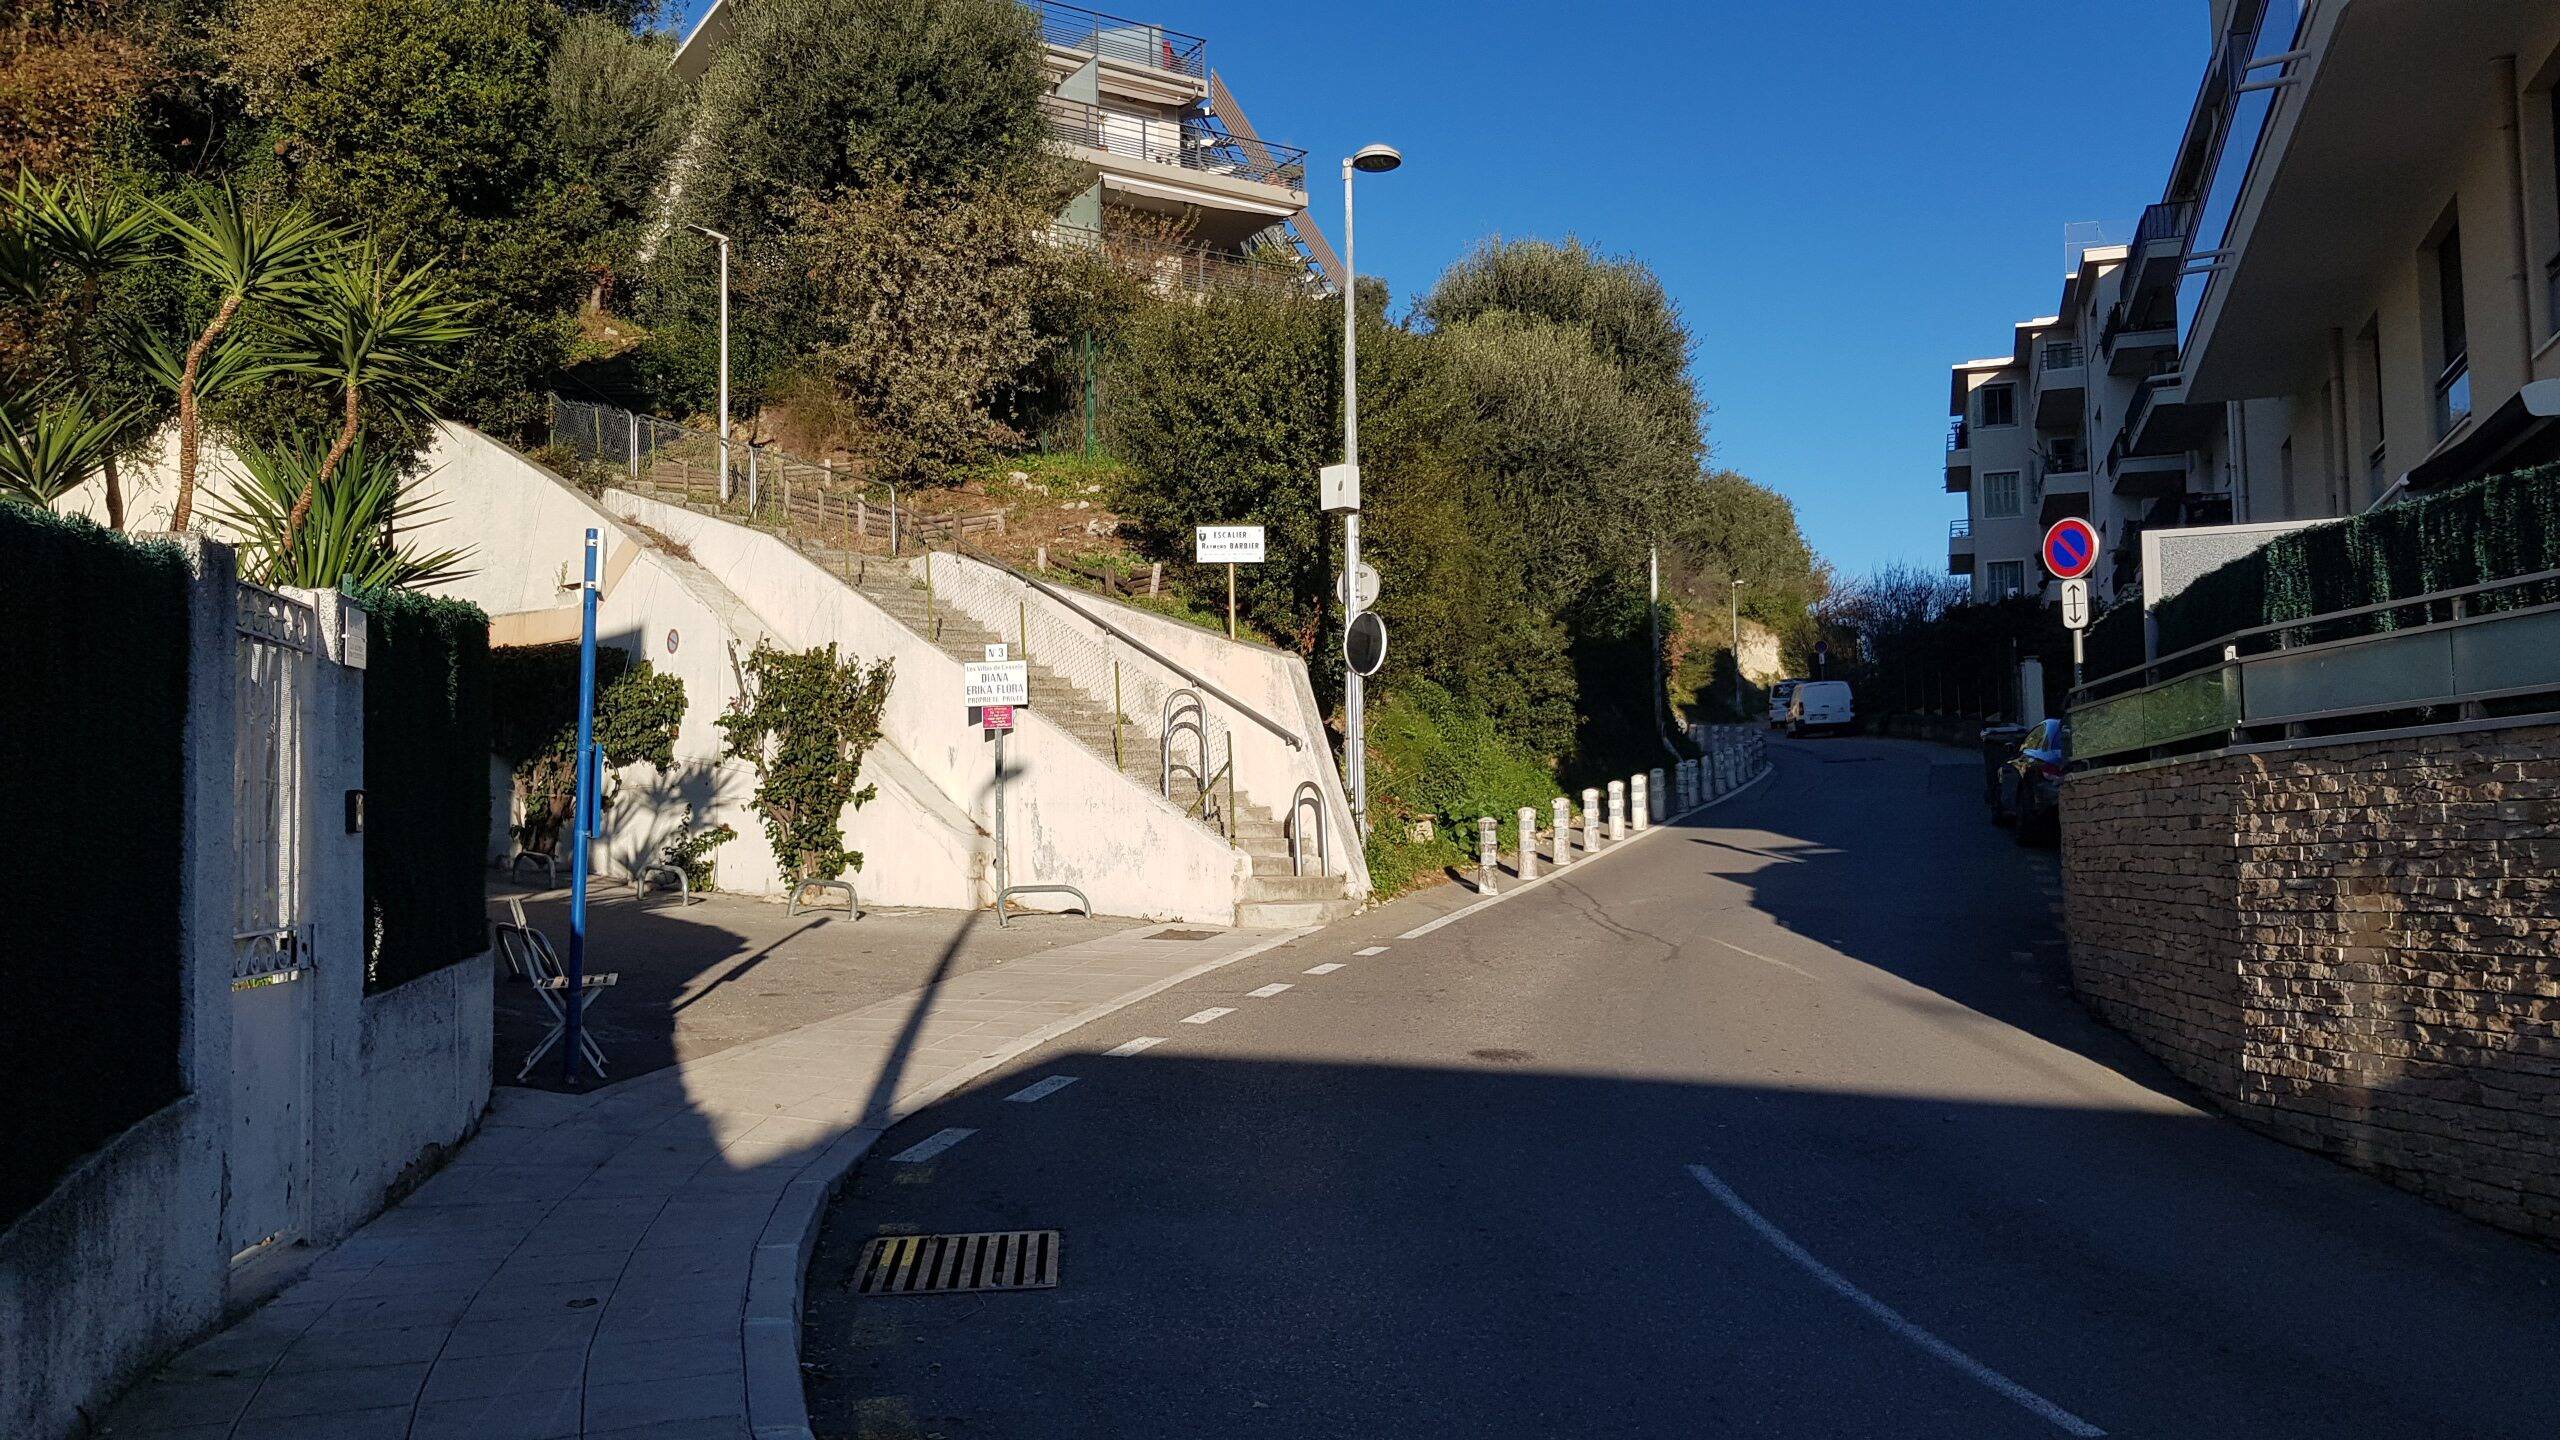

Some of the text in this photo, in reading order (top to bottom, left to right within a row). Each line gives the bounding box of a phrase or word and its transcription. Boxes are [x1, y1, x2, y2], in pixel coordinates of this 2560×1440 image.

[1213, 531, 1247, 539] ESCALIER
[998, 647, 1004, 657] 3
[981, 673, 1009, 683] DIANA
[966, 684, 1023, 695] ERIKA FLORA
